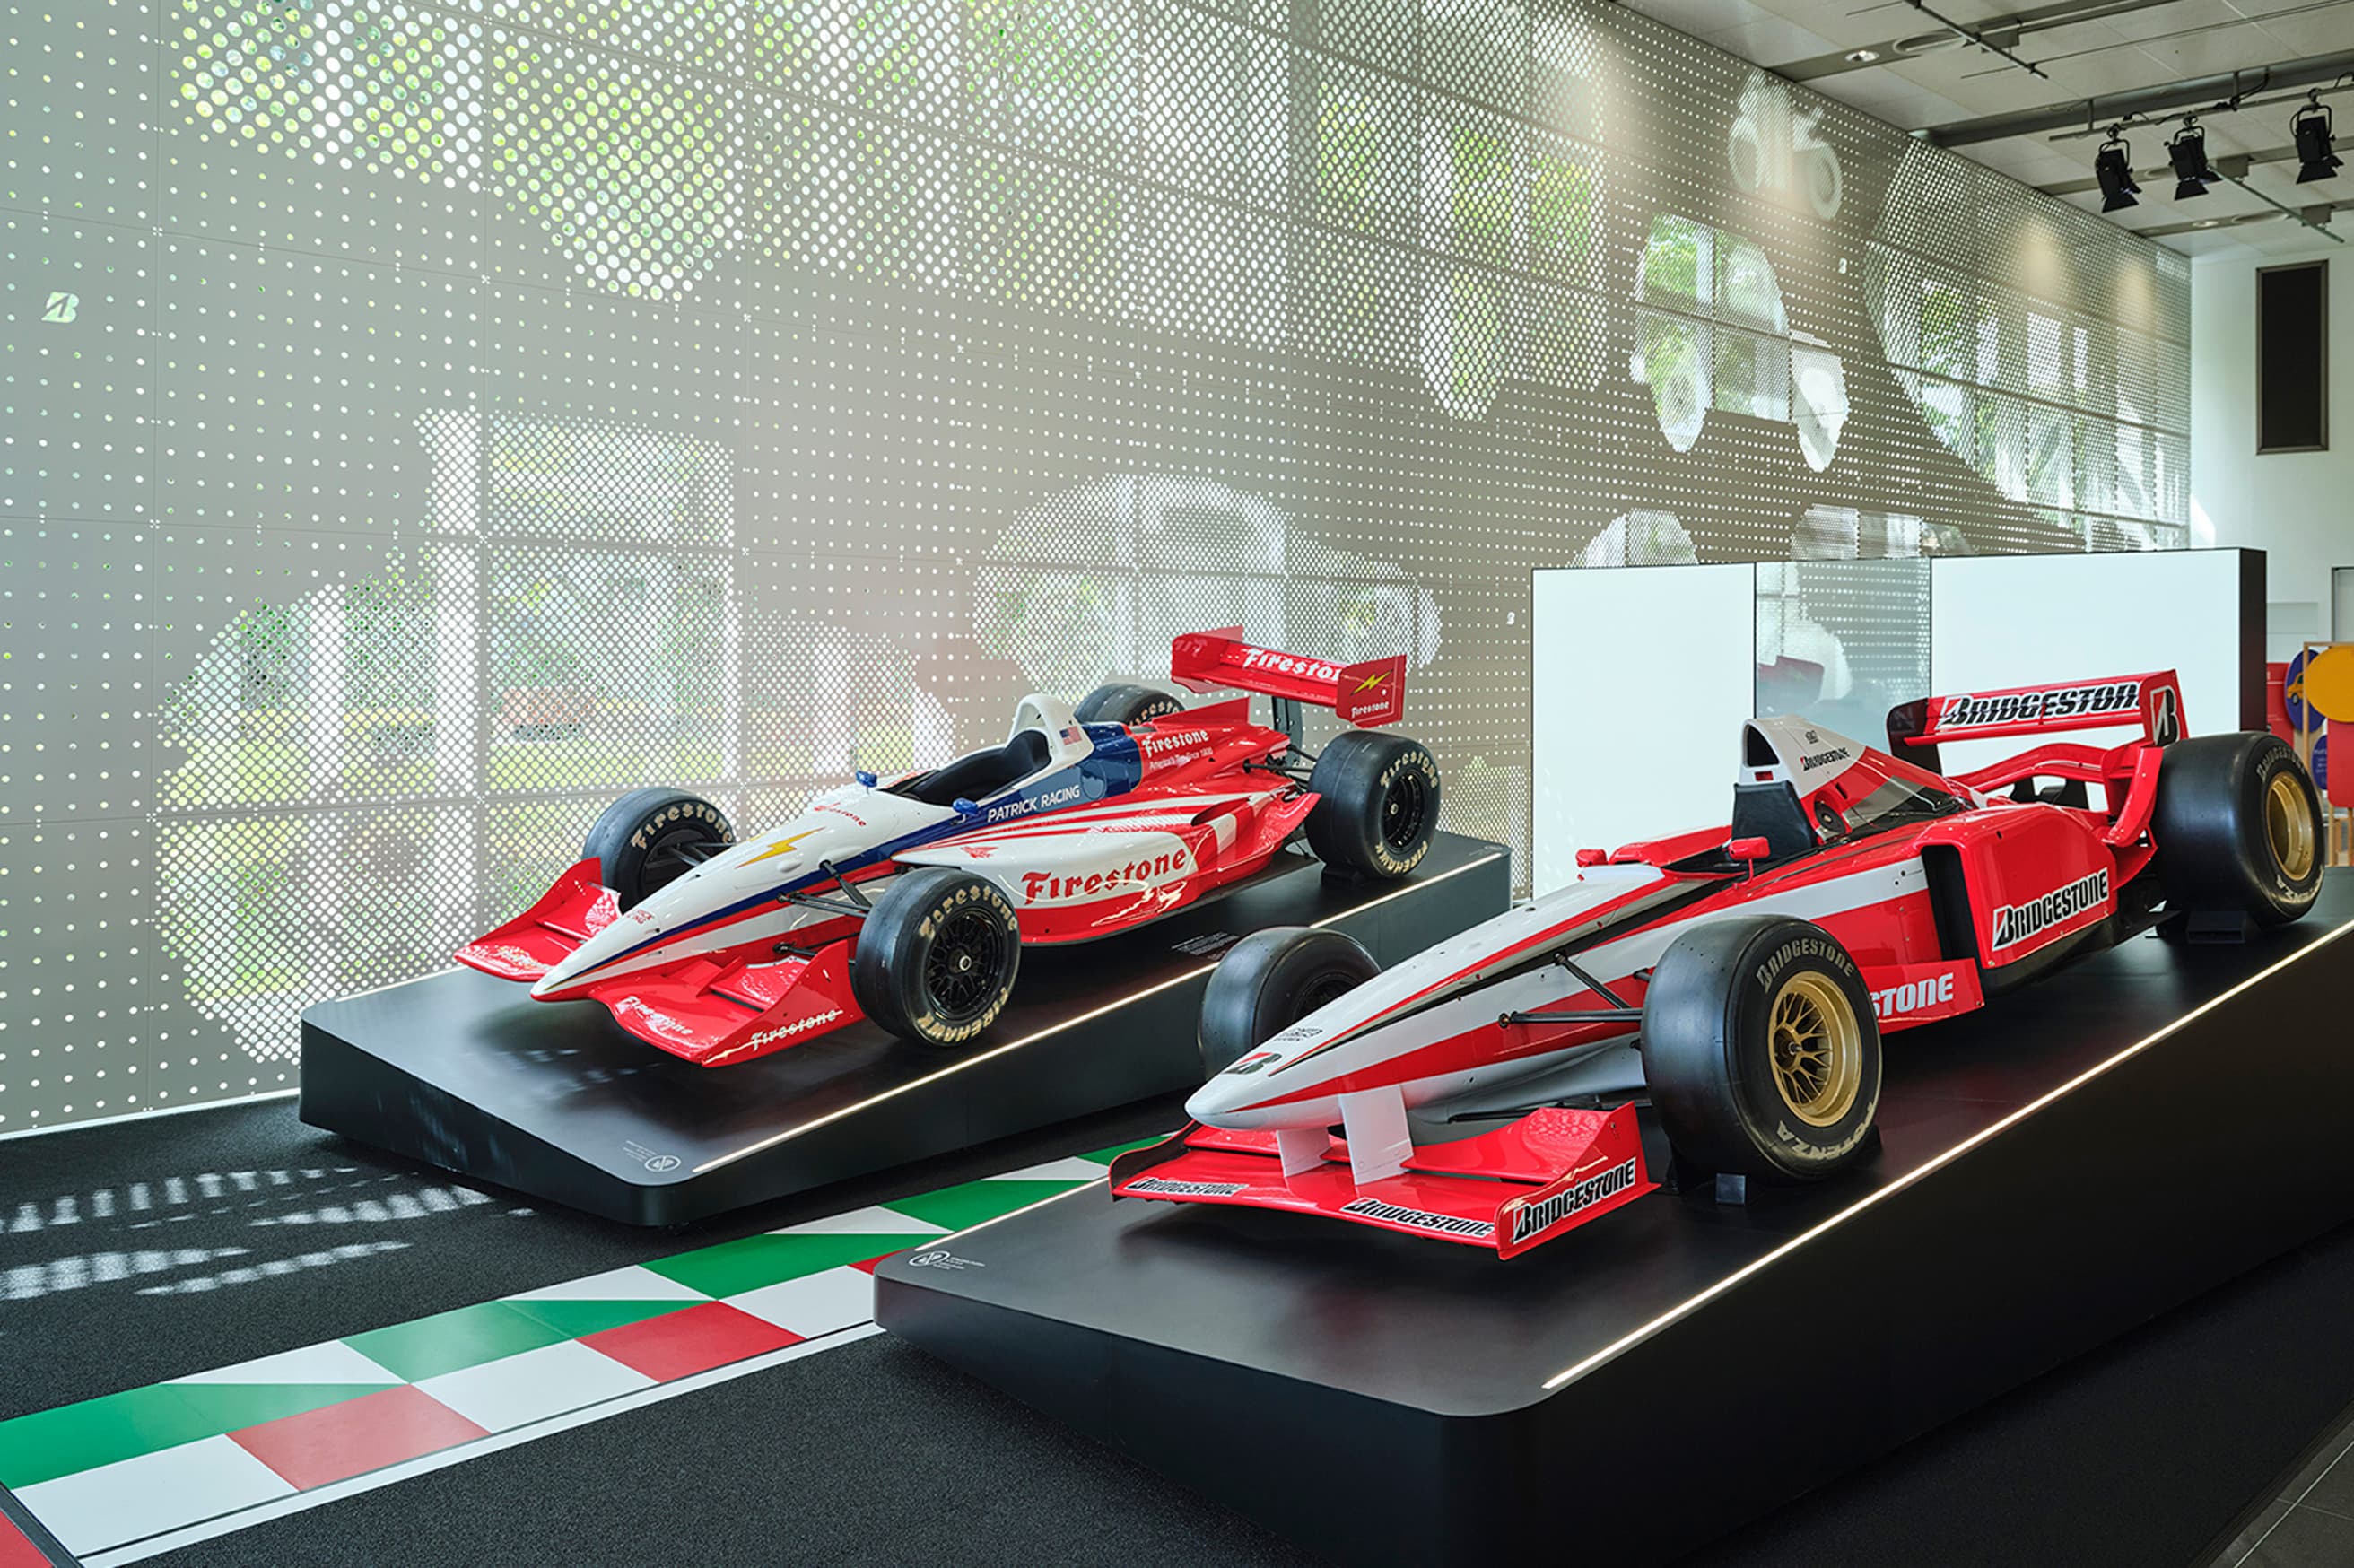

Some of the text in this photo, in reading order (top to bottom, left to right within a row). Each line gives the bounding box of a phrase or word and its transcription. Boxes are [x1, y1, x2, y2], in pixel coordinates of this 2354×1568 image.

[1351, 701, 1390, 718] Firestone
[1940, 682, 2141, 726] BRIDGESTON
[1141, 730, 1209, 758] Firestone
[1380, 751, 1438, 788] Firestone
[987, 785, 1081, 823] PATRICK RACING
[630, 803, 734, 850] Firestone
[1021, 848, 1187, 905] Firestone
[1374, 841, 1428, 874] FIREHAWK
[920, 884, 1018, 940] Firestone
[1992, 868, 2108, 950] BRIDGESTONE
[1756, 938, 1854, 993] BRIDGESTONE
[751, 1009, 838, 1050] Firestone
[917, 987, 1009, 1042] FIREHAWK
[1340, 1198, 1495, 1236] BRIDGESTONE
[1513, 1159, 1635, 1243] BRIDGESTONE
